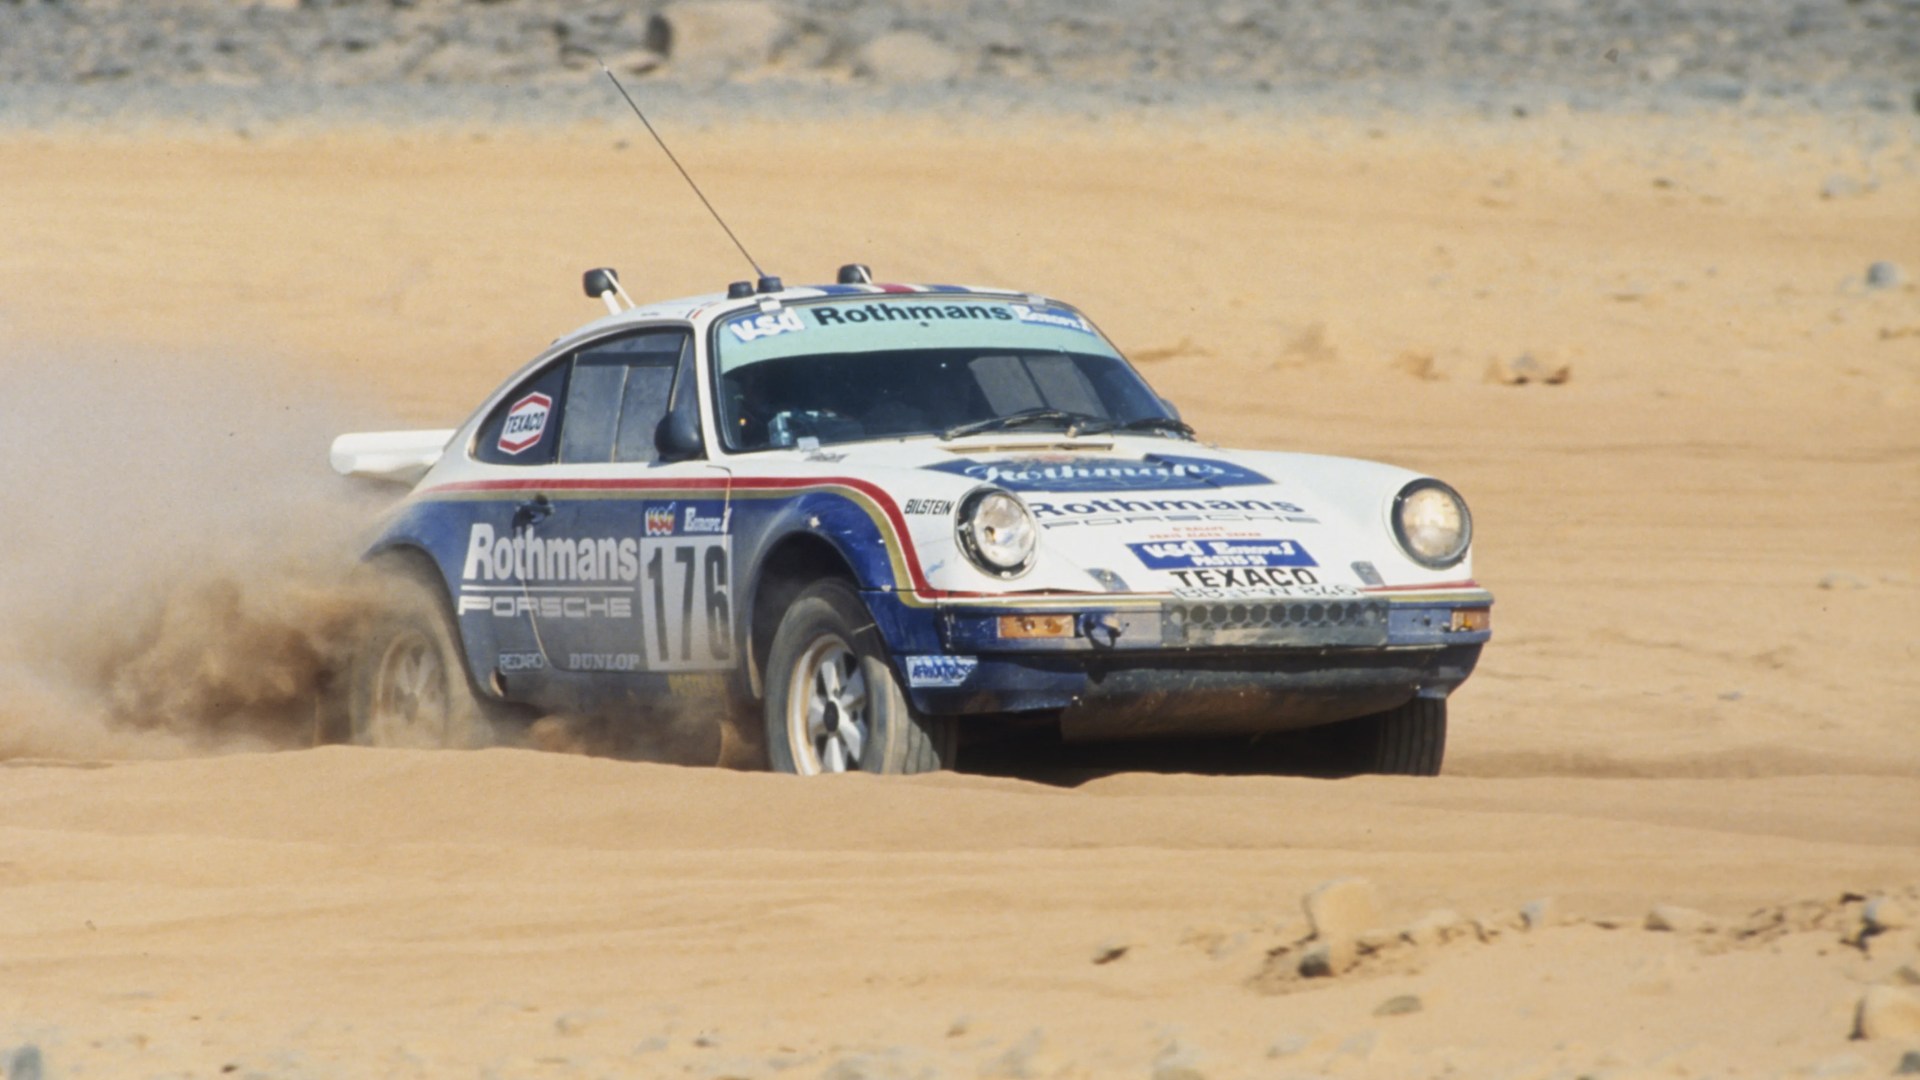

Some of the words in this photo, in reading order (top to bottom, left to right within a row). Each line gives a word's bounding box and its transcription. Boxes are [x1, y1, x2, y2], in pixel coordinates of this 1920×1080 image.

[811, 302, 1013, 326] Rothmans
[505, 411, 545, 434] TEXACO
[904, 498, 956, 516] BILSTEIN
[1027, 498, 1305, 520] Rothmans
[1042, 514, 1321, 530] PORSCHE
[463, 523, 638, 581] Rothmans
[1170, 568, 1319, 587] TEXACO
[458, 595, 632, 618] PORSCHE
[648, 545, 730, 662] 176
[569, 653, 640, 670] DUNLOP
